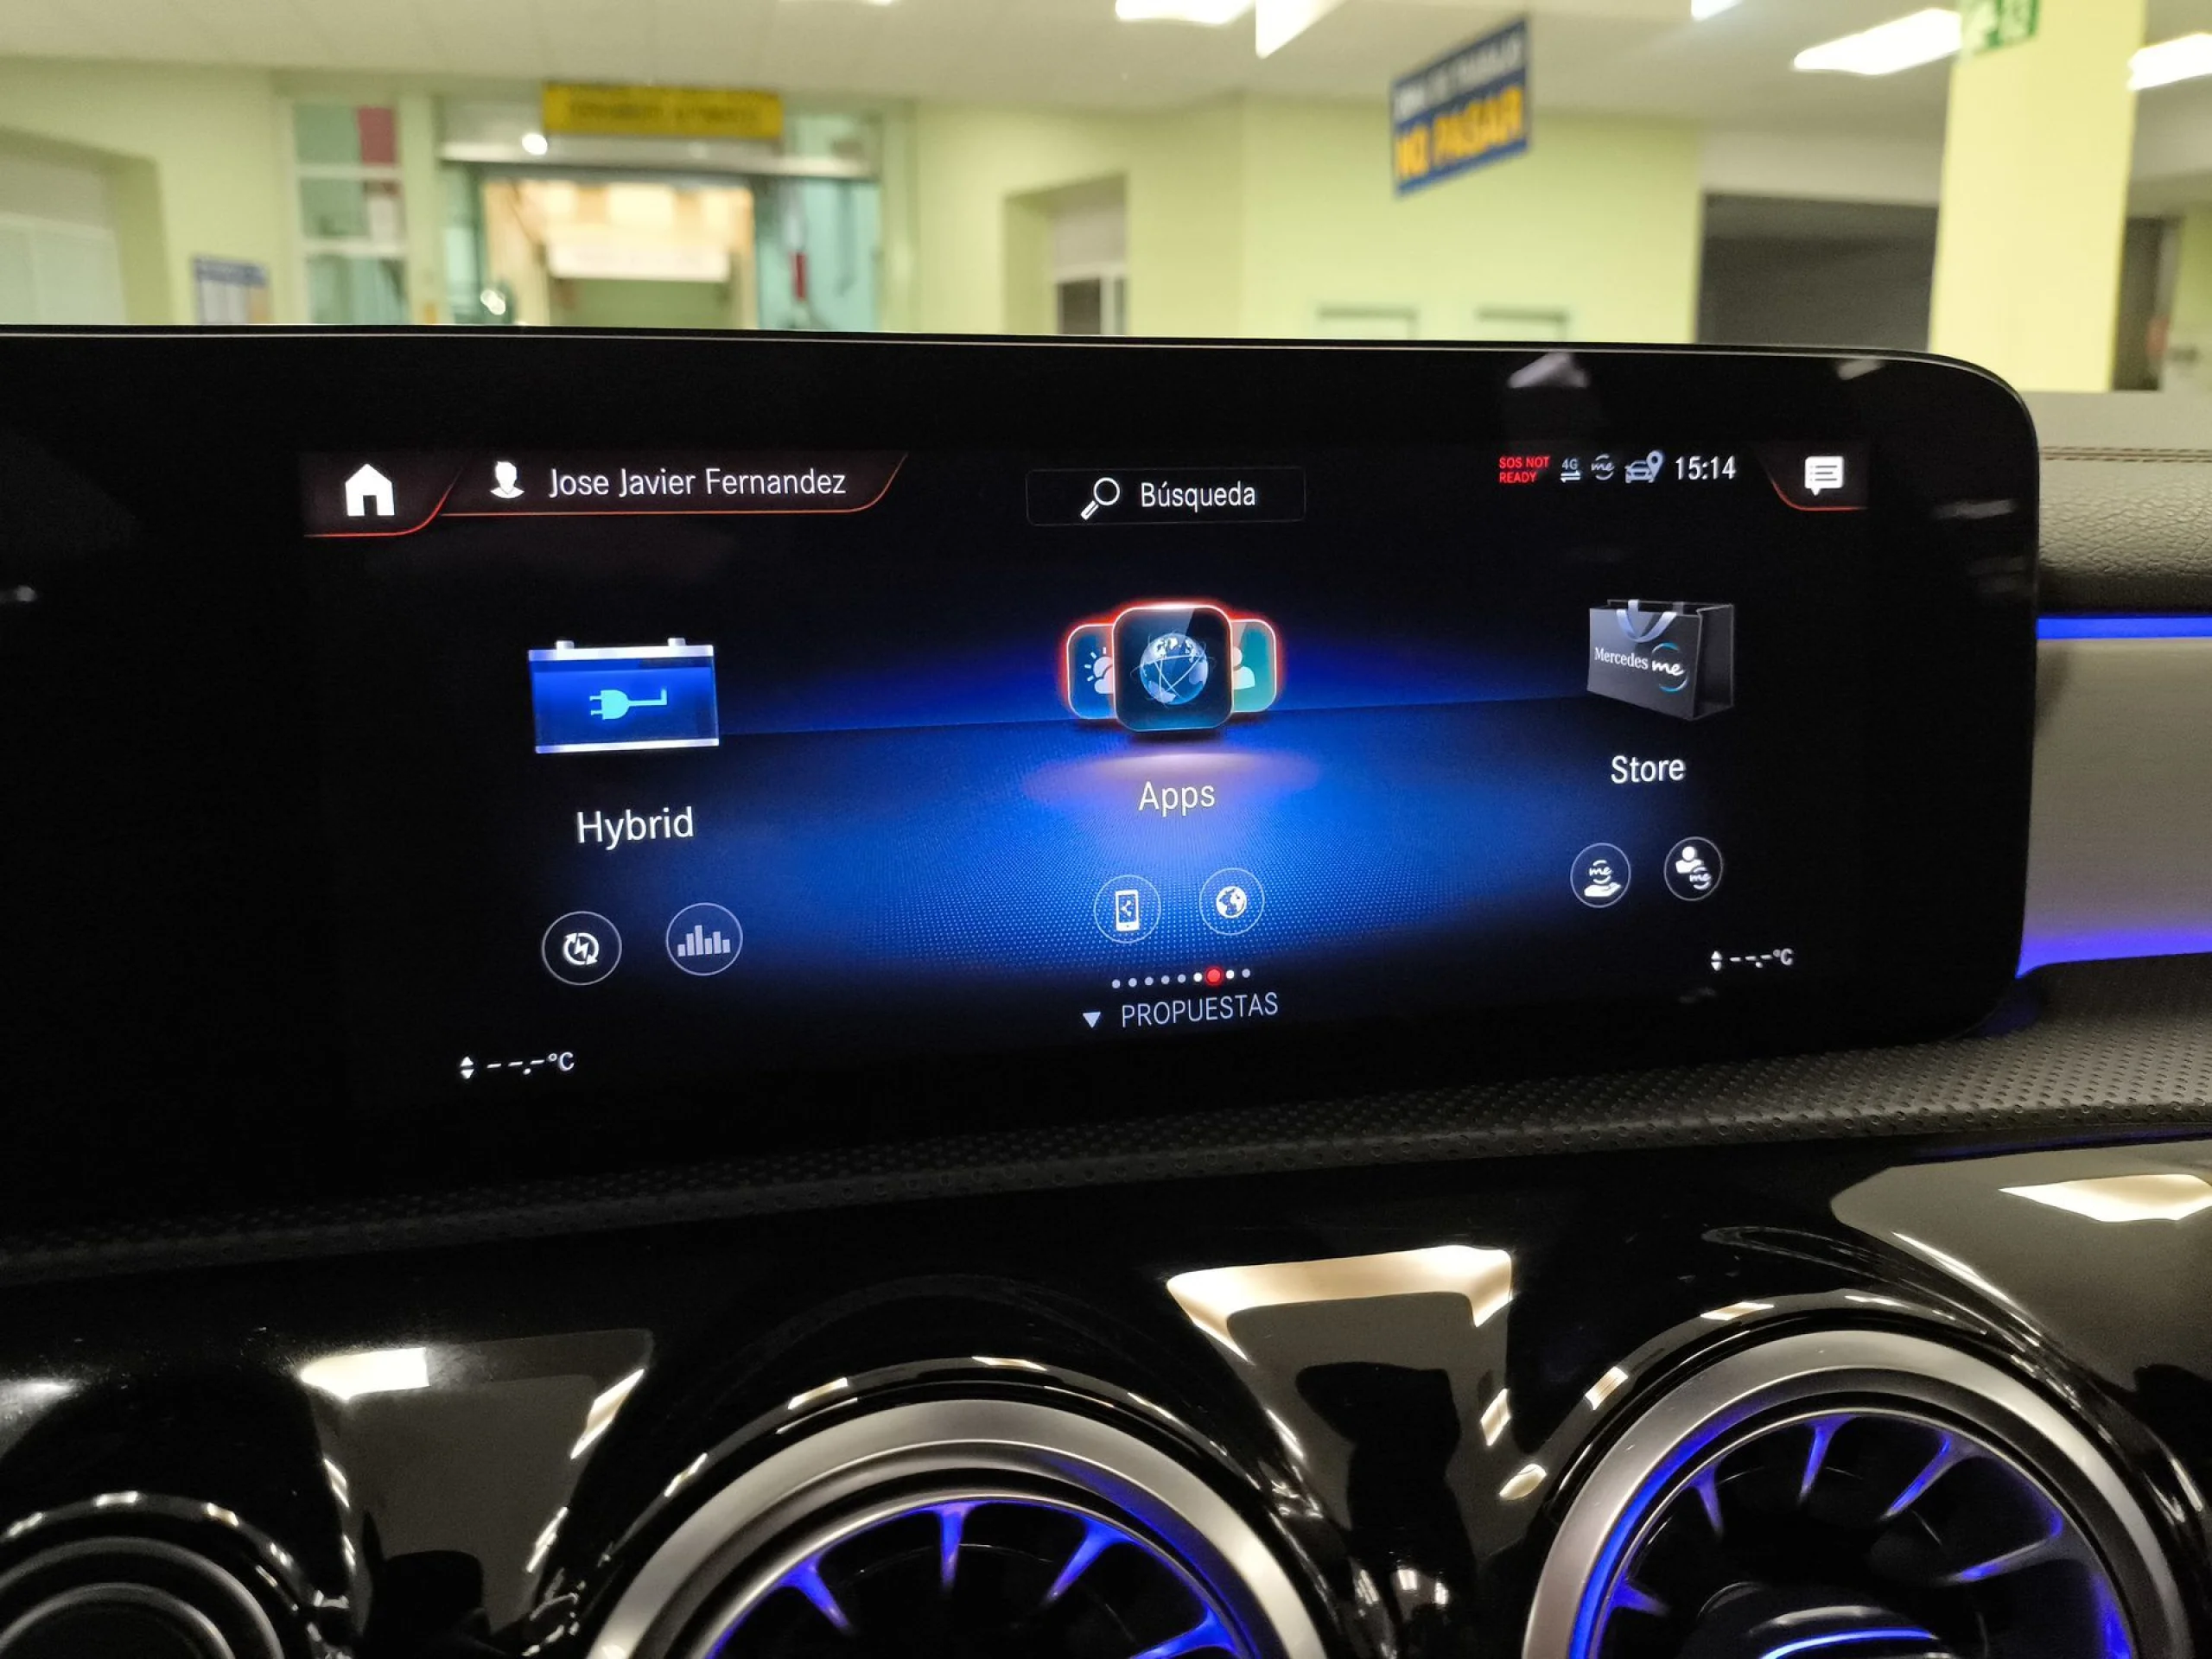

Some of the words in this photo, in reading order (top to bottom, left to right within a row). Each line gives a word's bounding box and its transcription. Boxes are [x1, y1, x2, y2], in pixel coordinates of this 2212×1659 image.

[1395, 124, 1429, 181] NO
[1498, 456, 1523, 469] SOS
[1526, 455, 1550, 468] NOT
[1498, 471, 1538, 484] READY
[1561, 458, 1579, 470] 4G
[1675, 455, 1737, 480] 15:14
[549, 467, 609, 498] Jose
[619, 467, 696, 497] Javier
[706, 467, 847, 495] Fernandez
[1141, 480, 1256, 513] Búsqueda
[1594, 646, 1649, 671] Mercedes
[1651, 659, 1685, 677] me
[1610, 754, 1686, 784] Store
[1138, 780, 1216, 817] Apps
[576, 805, 695, 851] Hybrid
[1122, 991, 1280, 1028] PROPUESTAS
